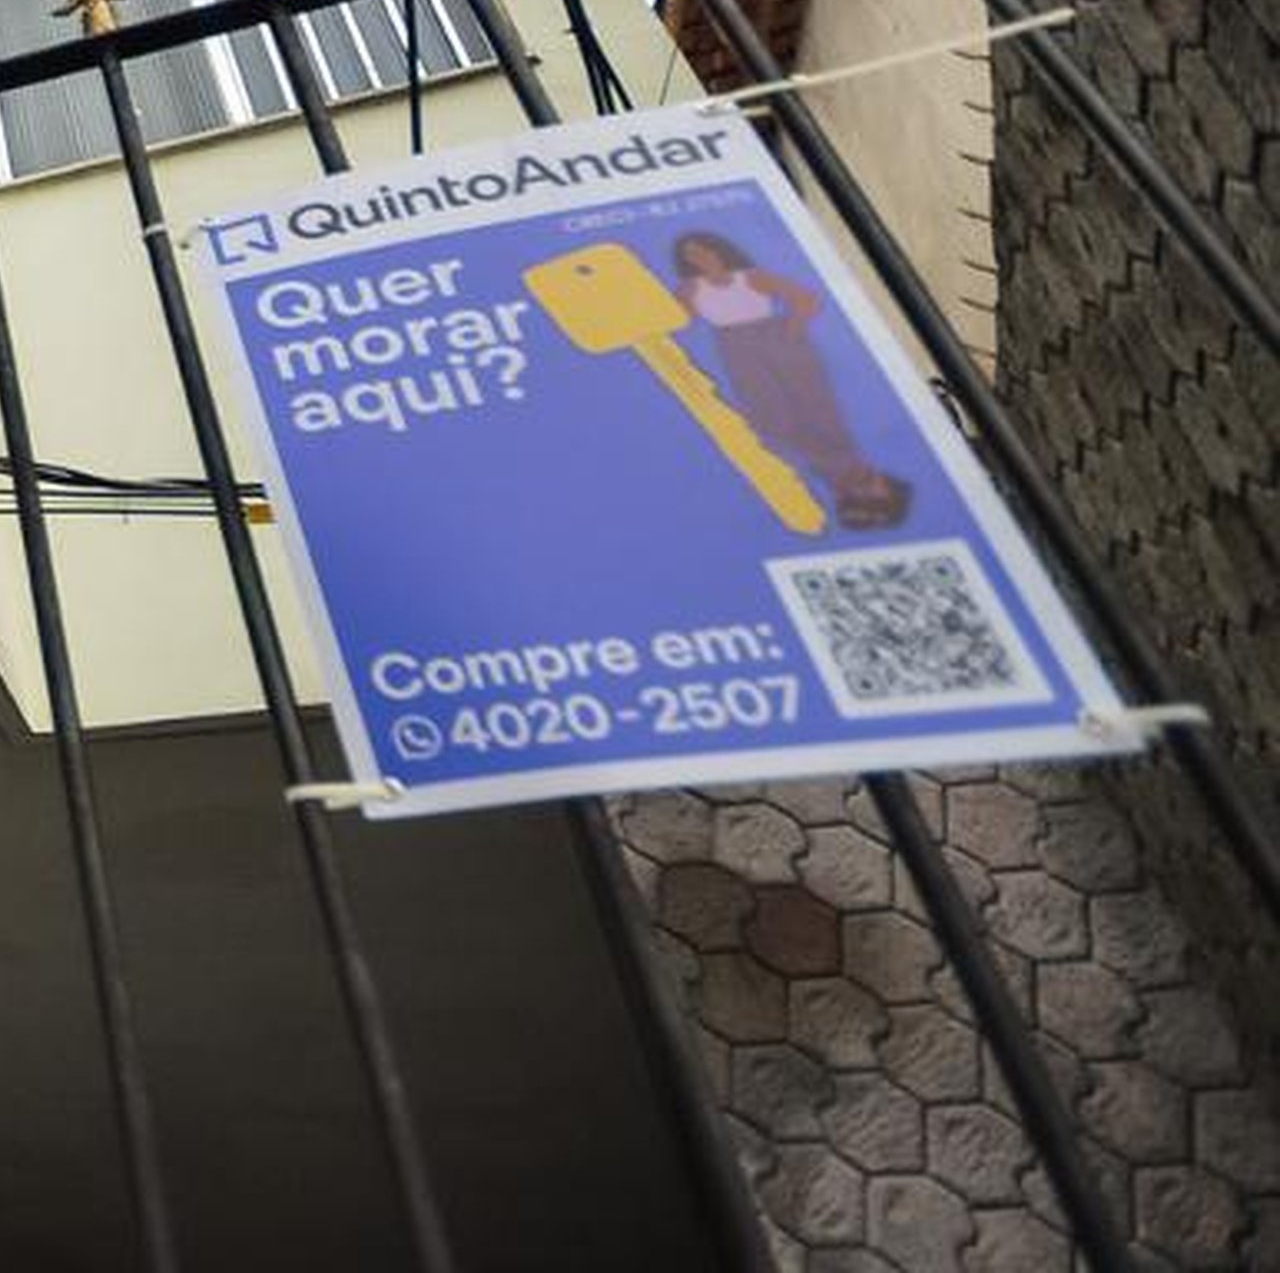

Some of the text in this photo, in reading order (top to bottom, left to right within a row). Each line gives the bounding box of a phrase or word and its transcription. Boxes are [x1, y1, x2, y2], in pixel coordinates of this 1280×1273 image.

[287, 129, 727, 239] QuintoAndar
[256, 257, 464, 327] Quer
[272, 301, 530, 381] morar
[290, 349, 526, 432] aqui?
[371, 623, 784, 700] Compre em:
[450, 676, 800, 752] 4020-2507
